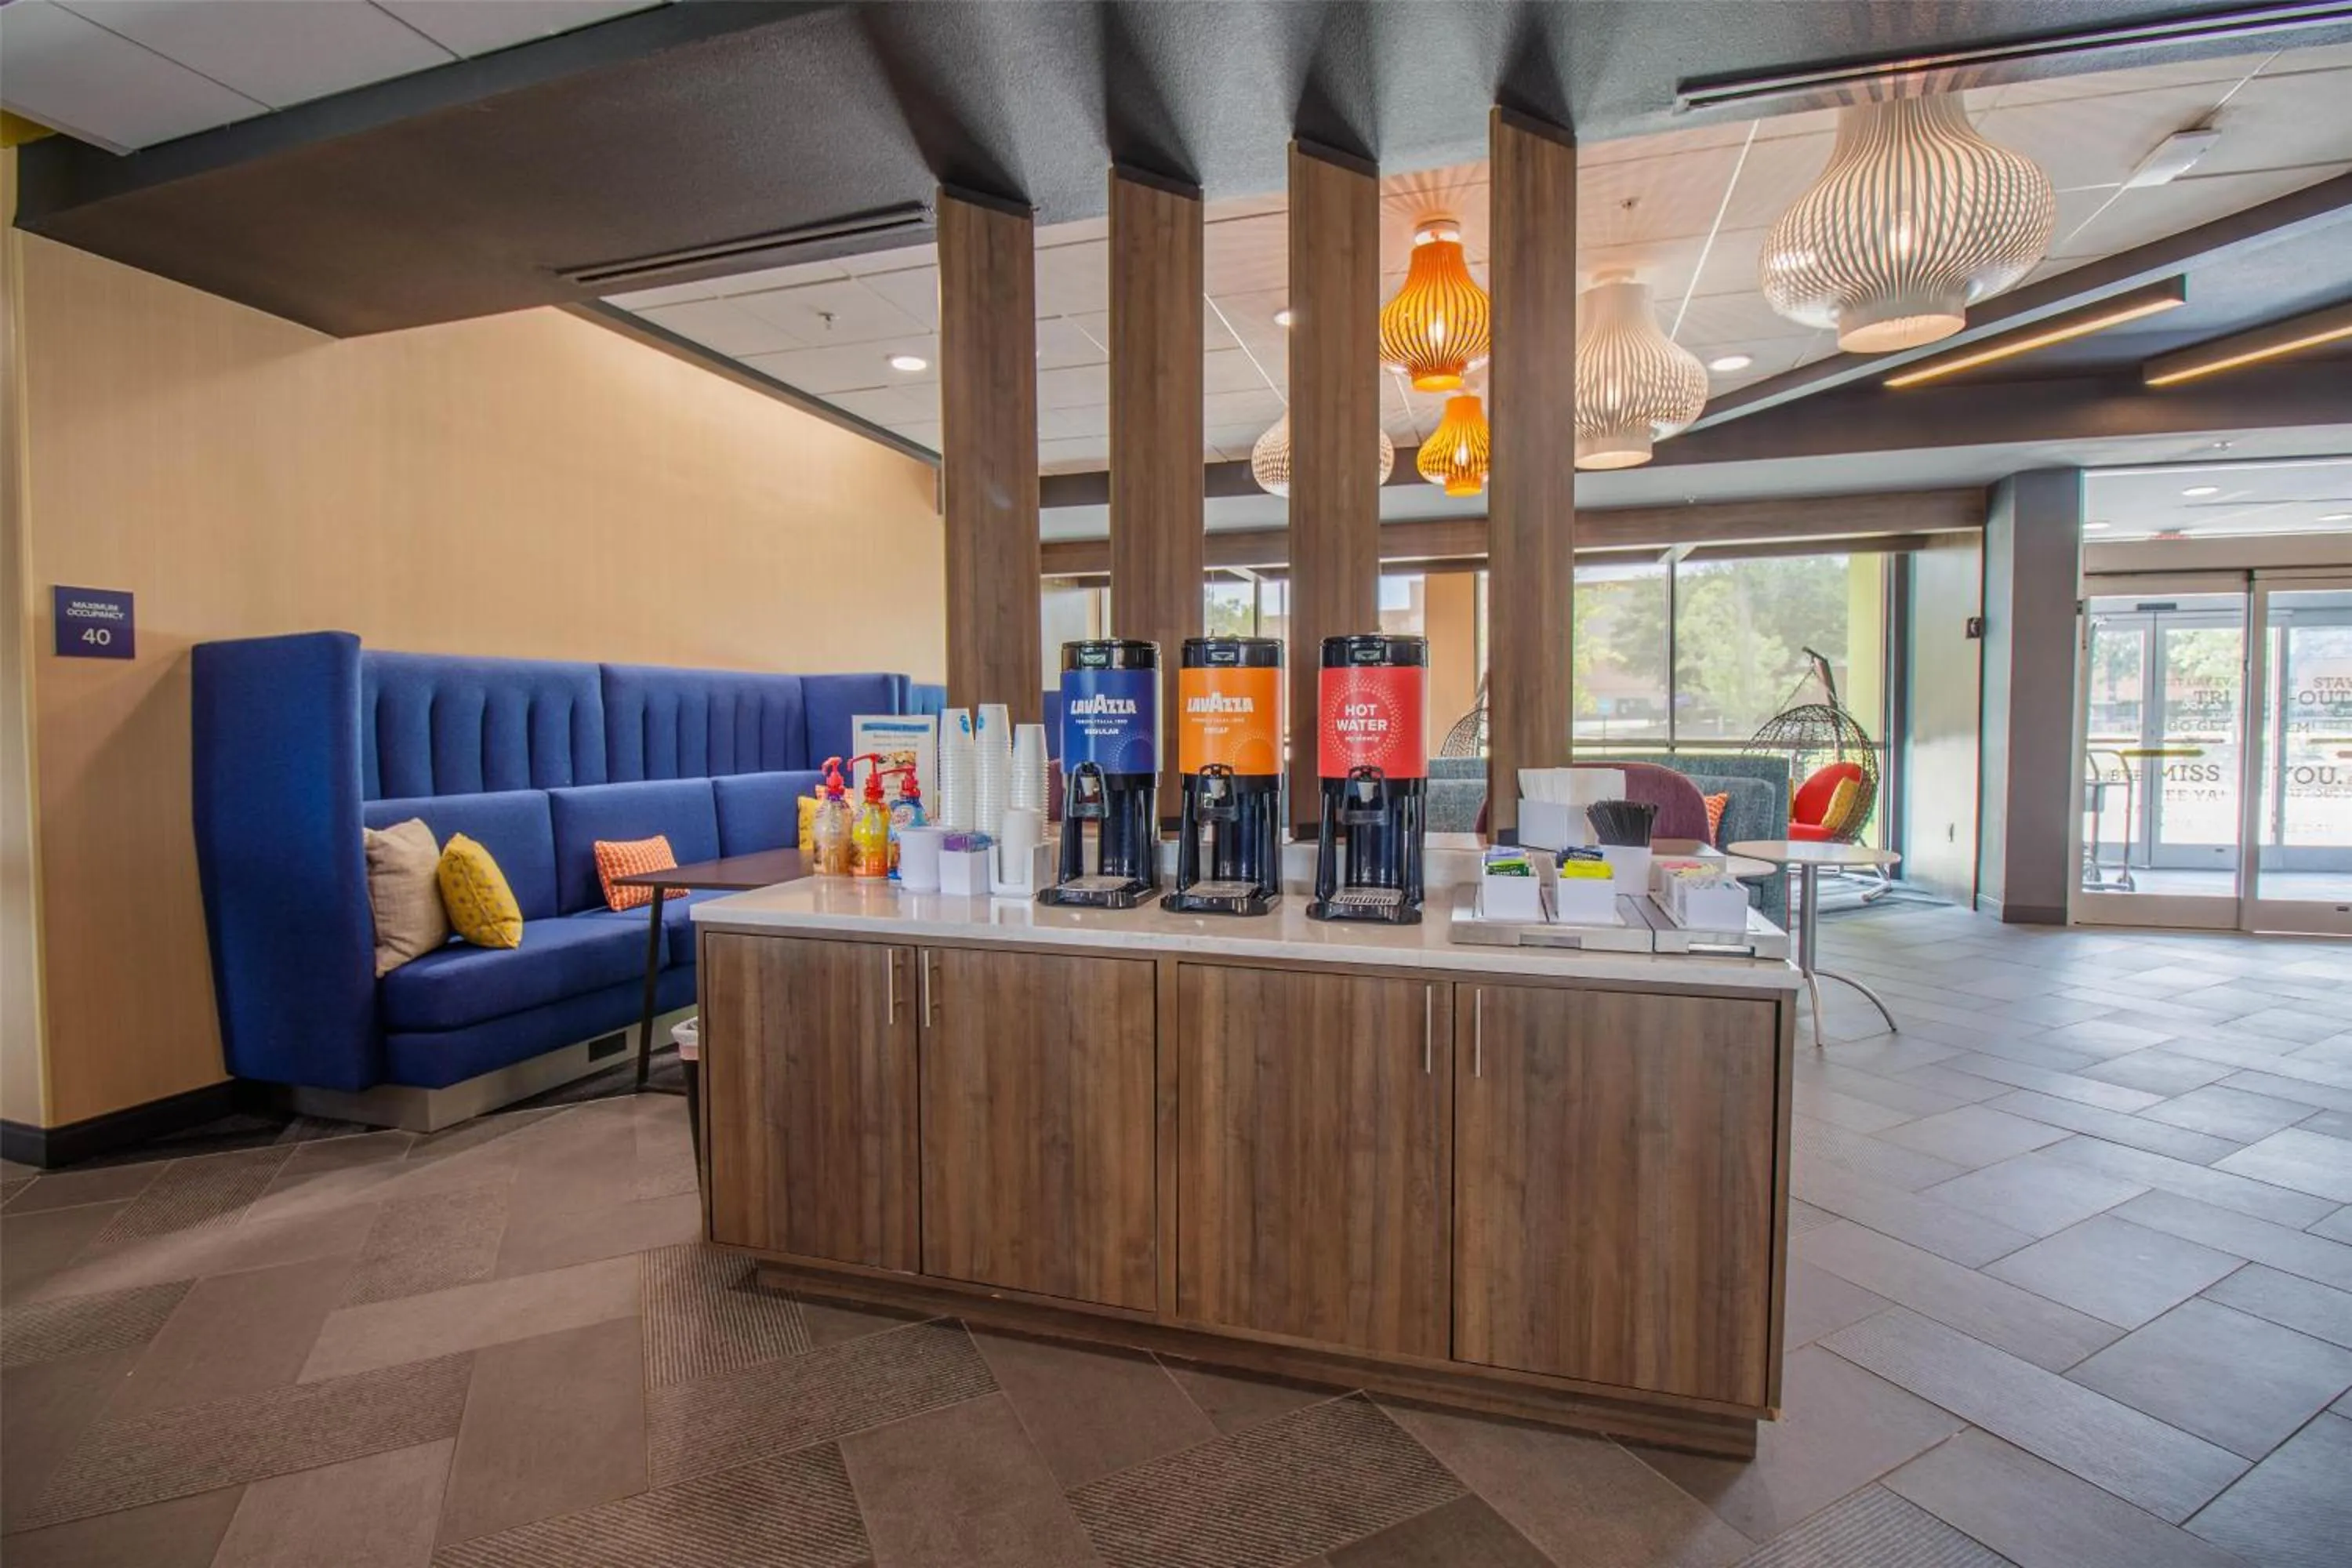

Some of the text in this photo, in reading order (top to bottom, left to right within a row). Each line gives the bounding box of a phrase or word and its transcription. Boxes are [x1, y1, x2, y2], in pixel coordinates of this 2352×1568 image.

[72, 601, 119, 611] MAXIMUM
[66, 608, 125, 620] OCCUPANCY
[82, 628, 111, 645] 40
[1070, 694, 1138, 714] LAVAZZA
[1186, 692, 1254, 713] LAVAZZA
[1345, 703, 1377, 717] HOT
[1336, 719, 1387, 731] WATER
[2285, 766, 2342, 785] OU.
